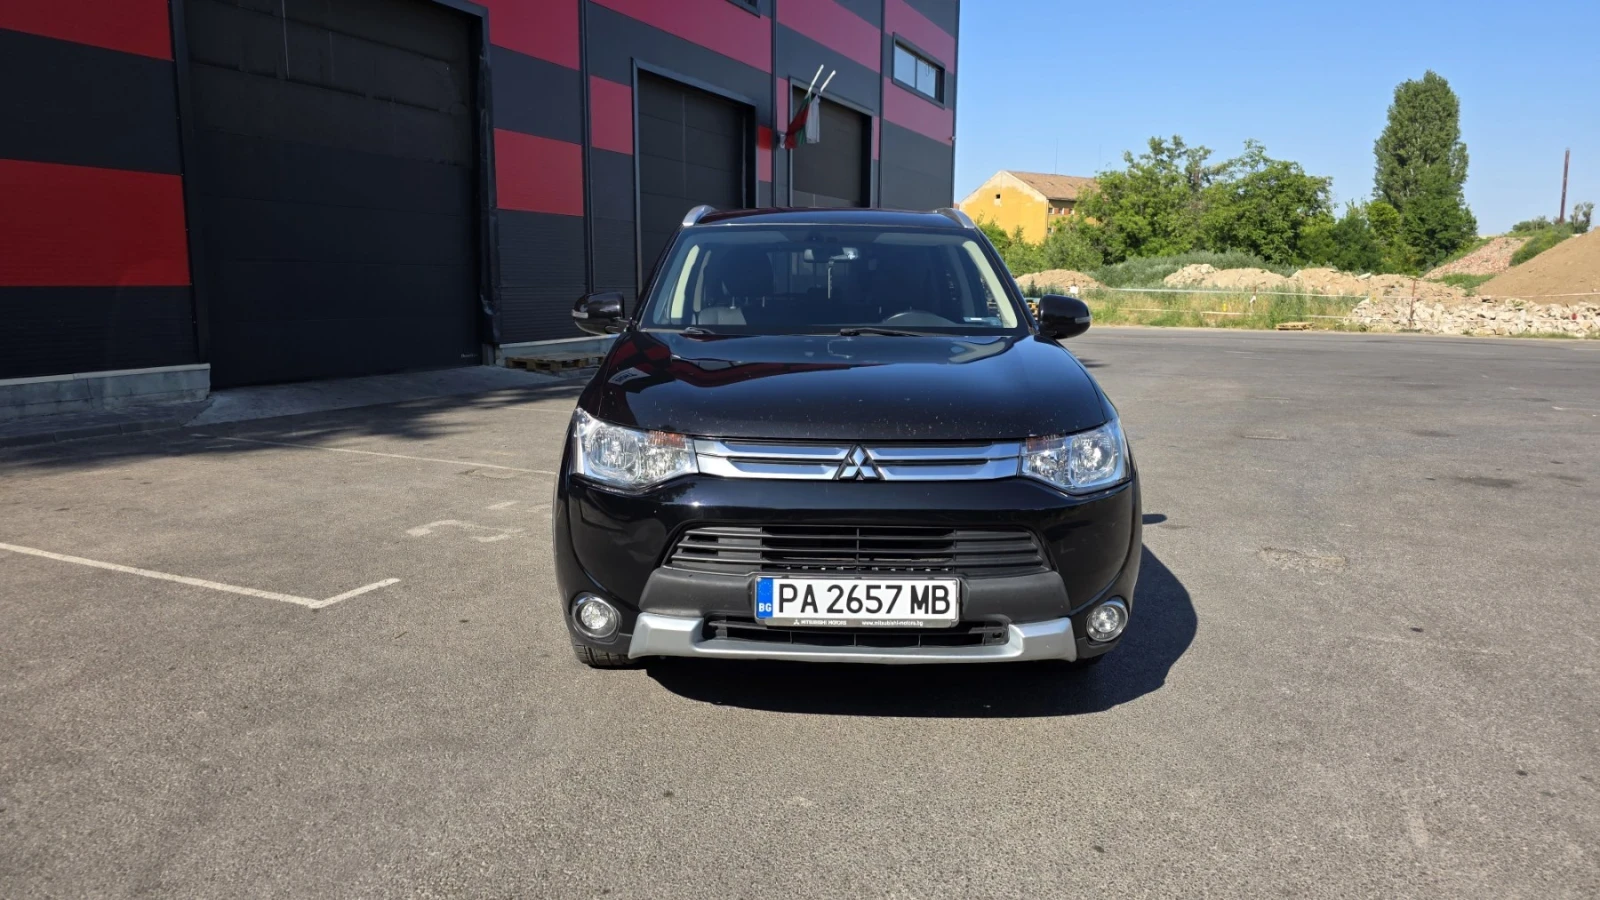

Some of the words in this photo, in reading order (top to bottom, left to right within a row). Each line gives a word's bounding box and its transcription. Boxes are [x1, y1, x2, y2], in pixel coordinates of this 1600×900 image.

[758, 603, 772, 612] BG
[779, 584, 819, 613] PA
[826, 585, 903, 614] 2657
[910, 585, 950, 614] MB
